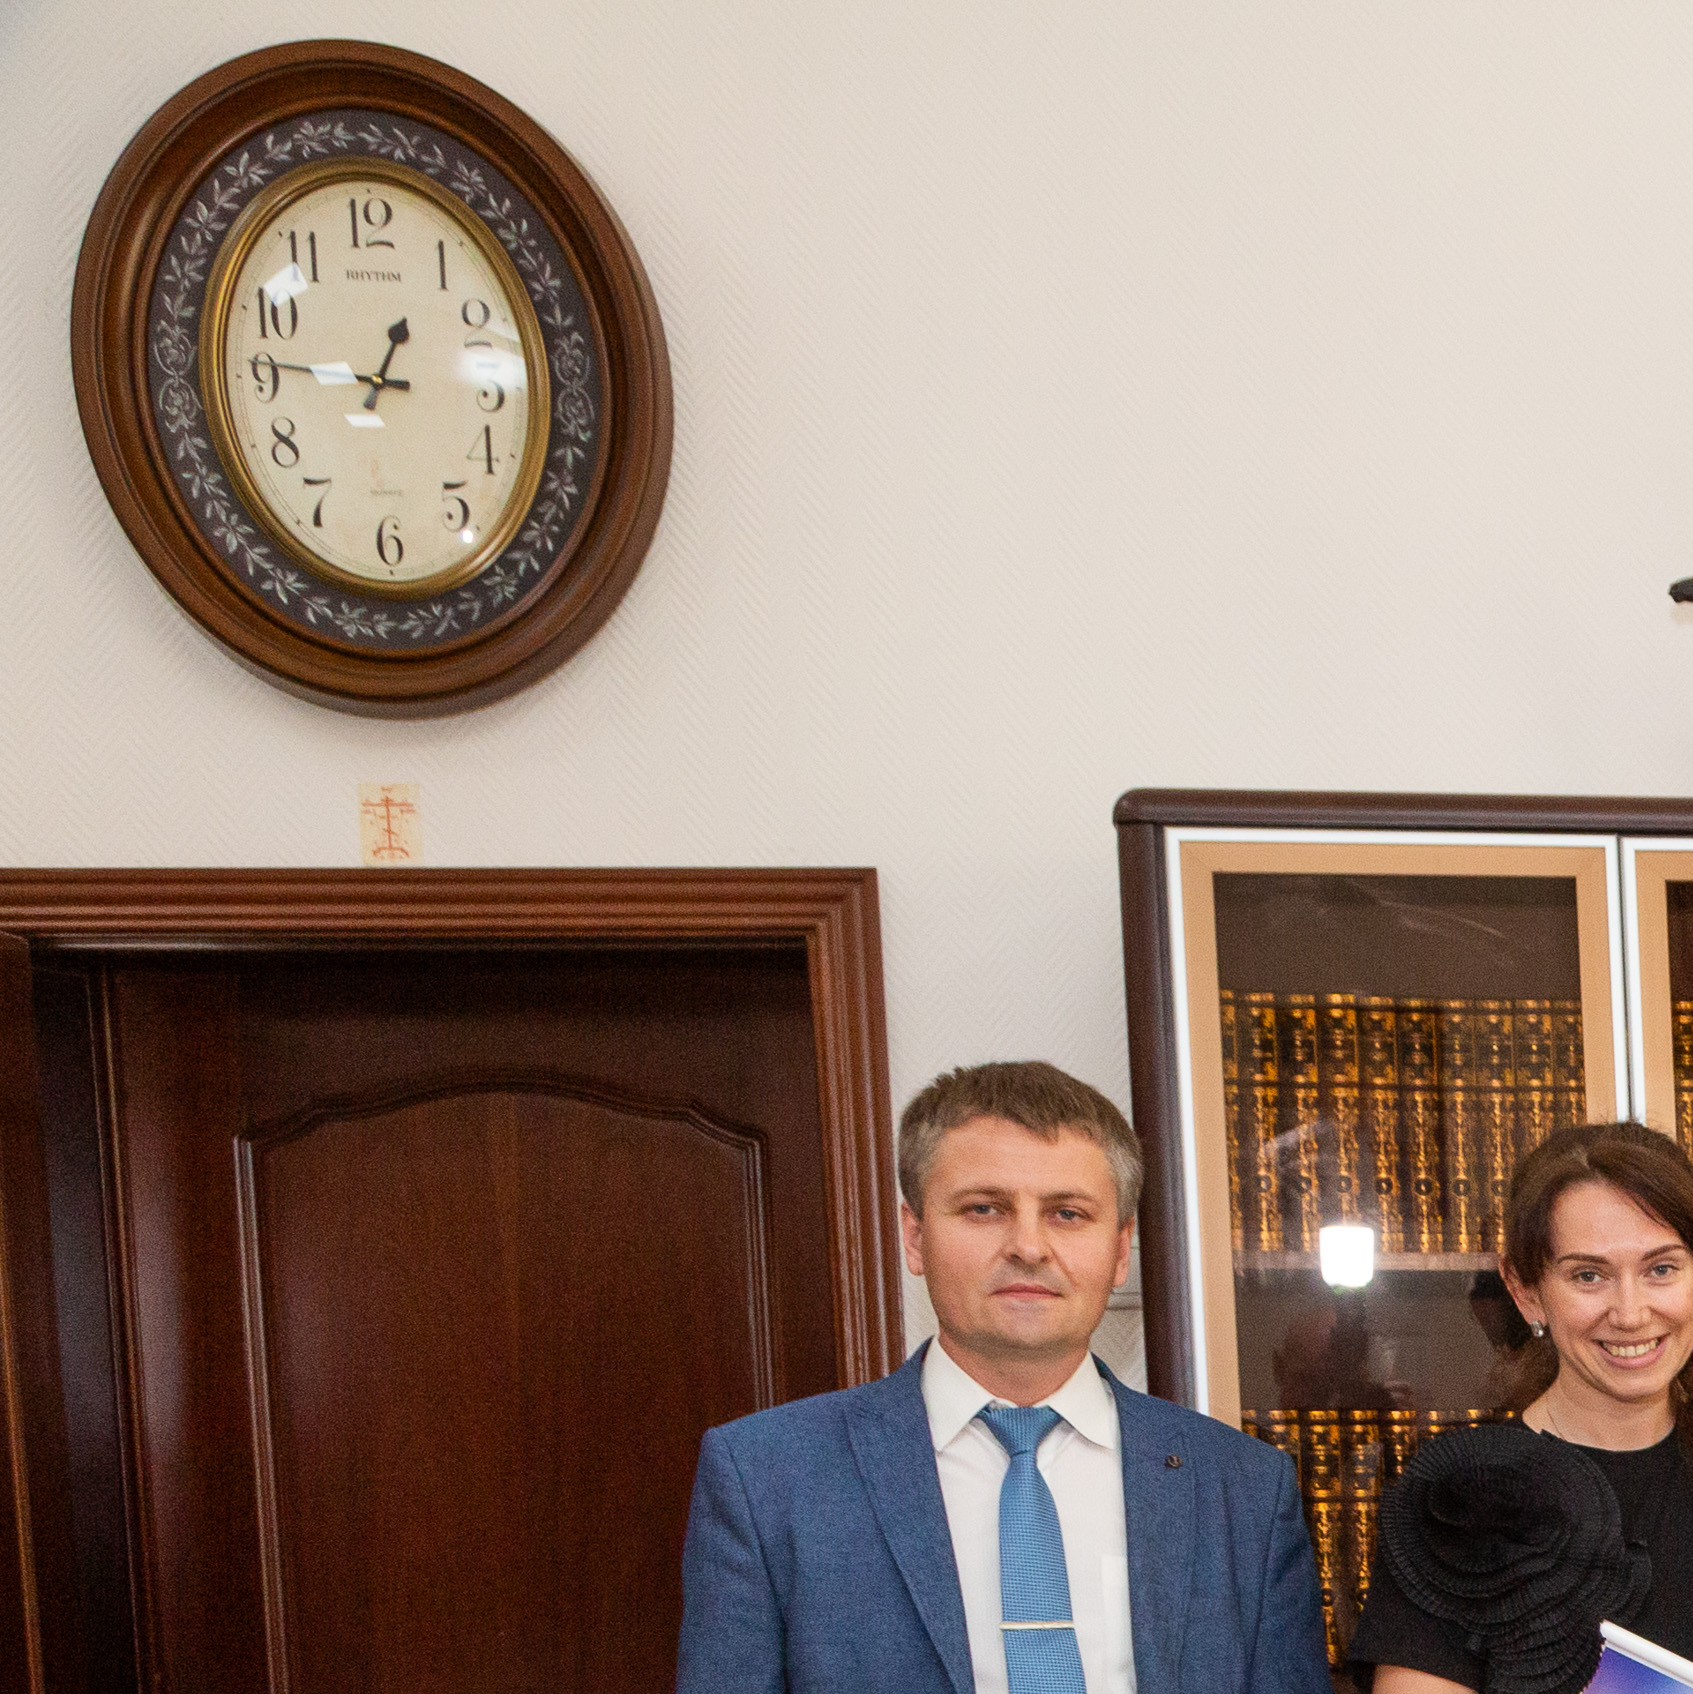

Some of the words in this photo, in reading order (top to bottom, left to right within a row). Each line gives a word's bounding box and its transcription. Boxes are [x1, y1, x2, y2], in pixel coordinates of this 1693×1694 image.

[350, 198, 396, 249] 12
[289, 230, 320, 283] 11
[345, 269, 402, 282] RHYTHM
[437, 239, 449, 291] 1
[256, 286, 299, 339] 10
[461, 299, 493, 349] 2
[251, 352, 280, 403] 9
[270, 416, 300, 468] 8
[466, 424, 501, 475] 4
[303, 477, 333, 528] 7
[442, 480, 471, 532] 5
[376, 514, 404, 567] 6
